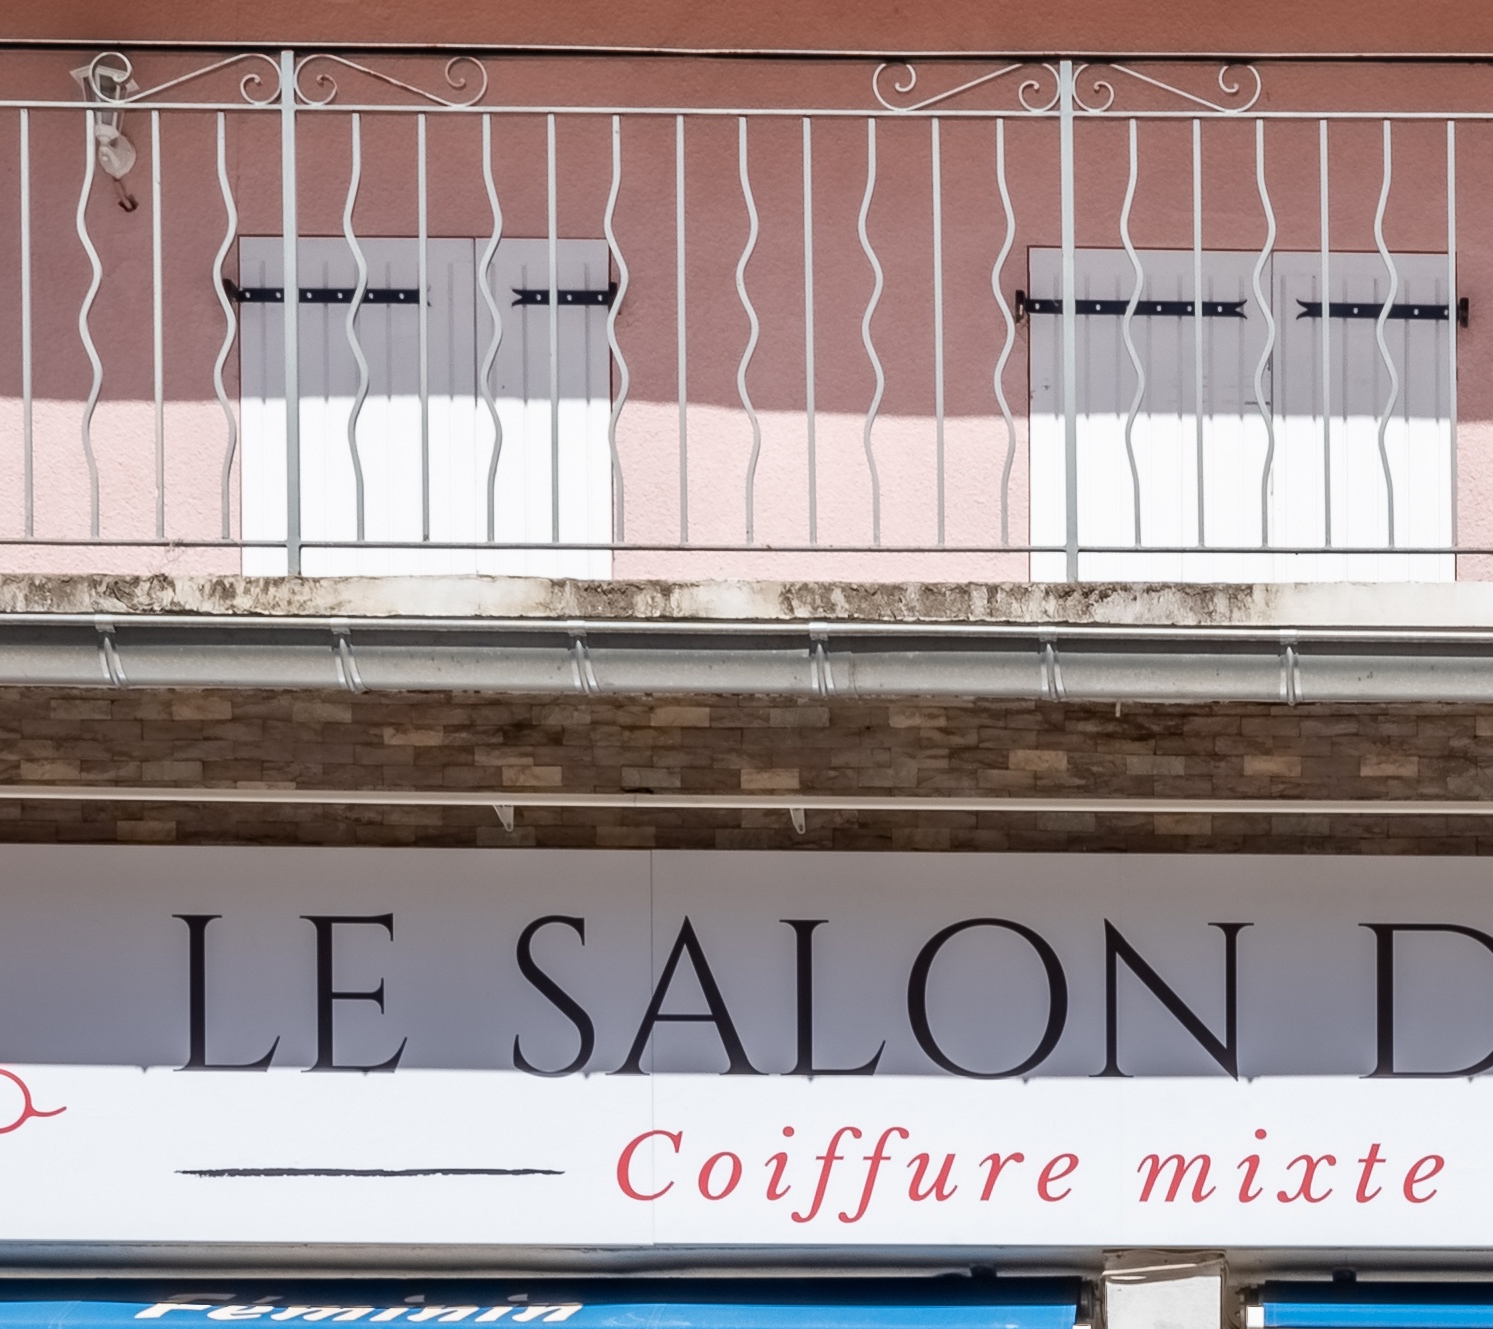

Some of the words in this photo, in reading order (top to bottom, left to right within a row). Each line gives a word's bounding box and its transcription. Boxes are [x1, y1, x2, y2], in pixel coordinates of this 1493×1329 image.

[173, 914, 408, 1073] LE
[512, 914, 1254, 1081] SALON
[616, 1126, 1079, 1223] Coiffure
[1140, 1128, 1445, 1203] mixte
[134, 1293, 583, 1323] Féminin
